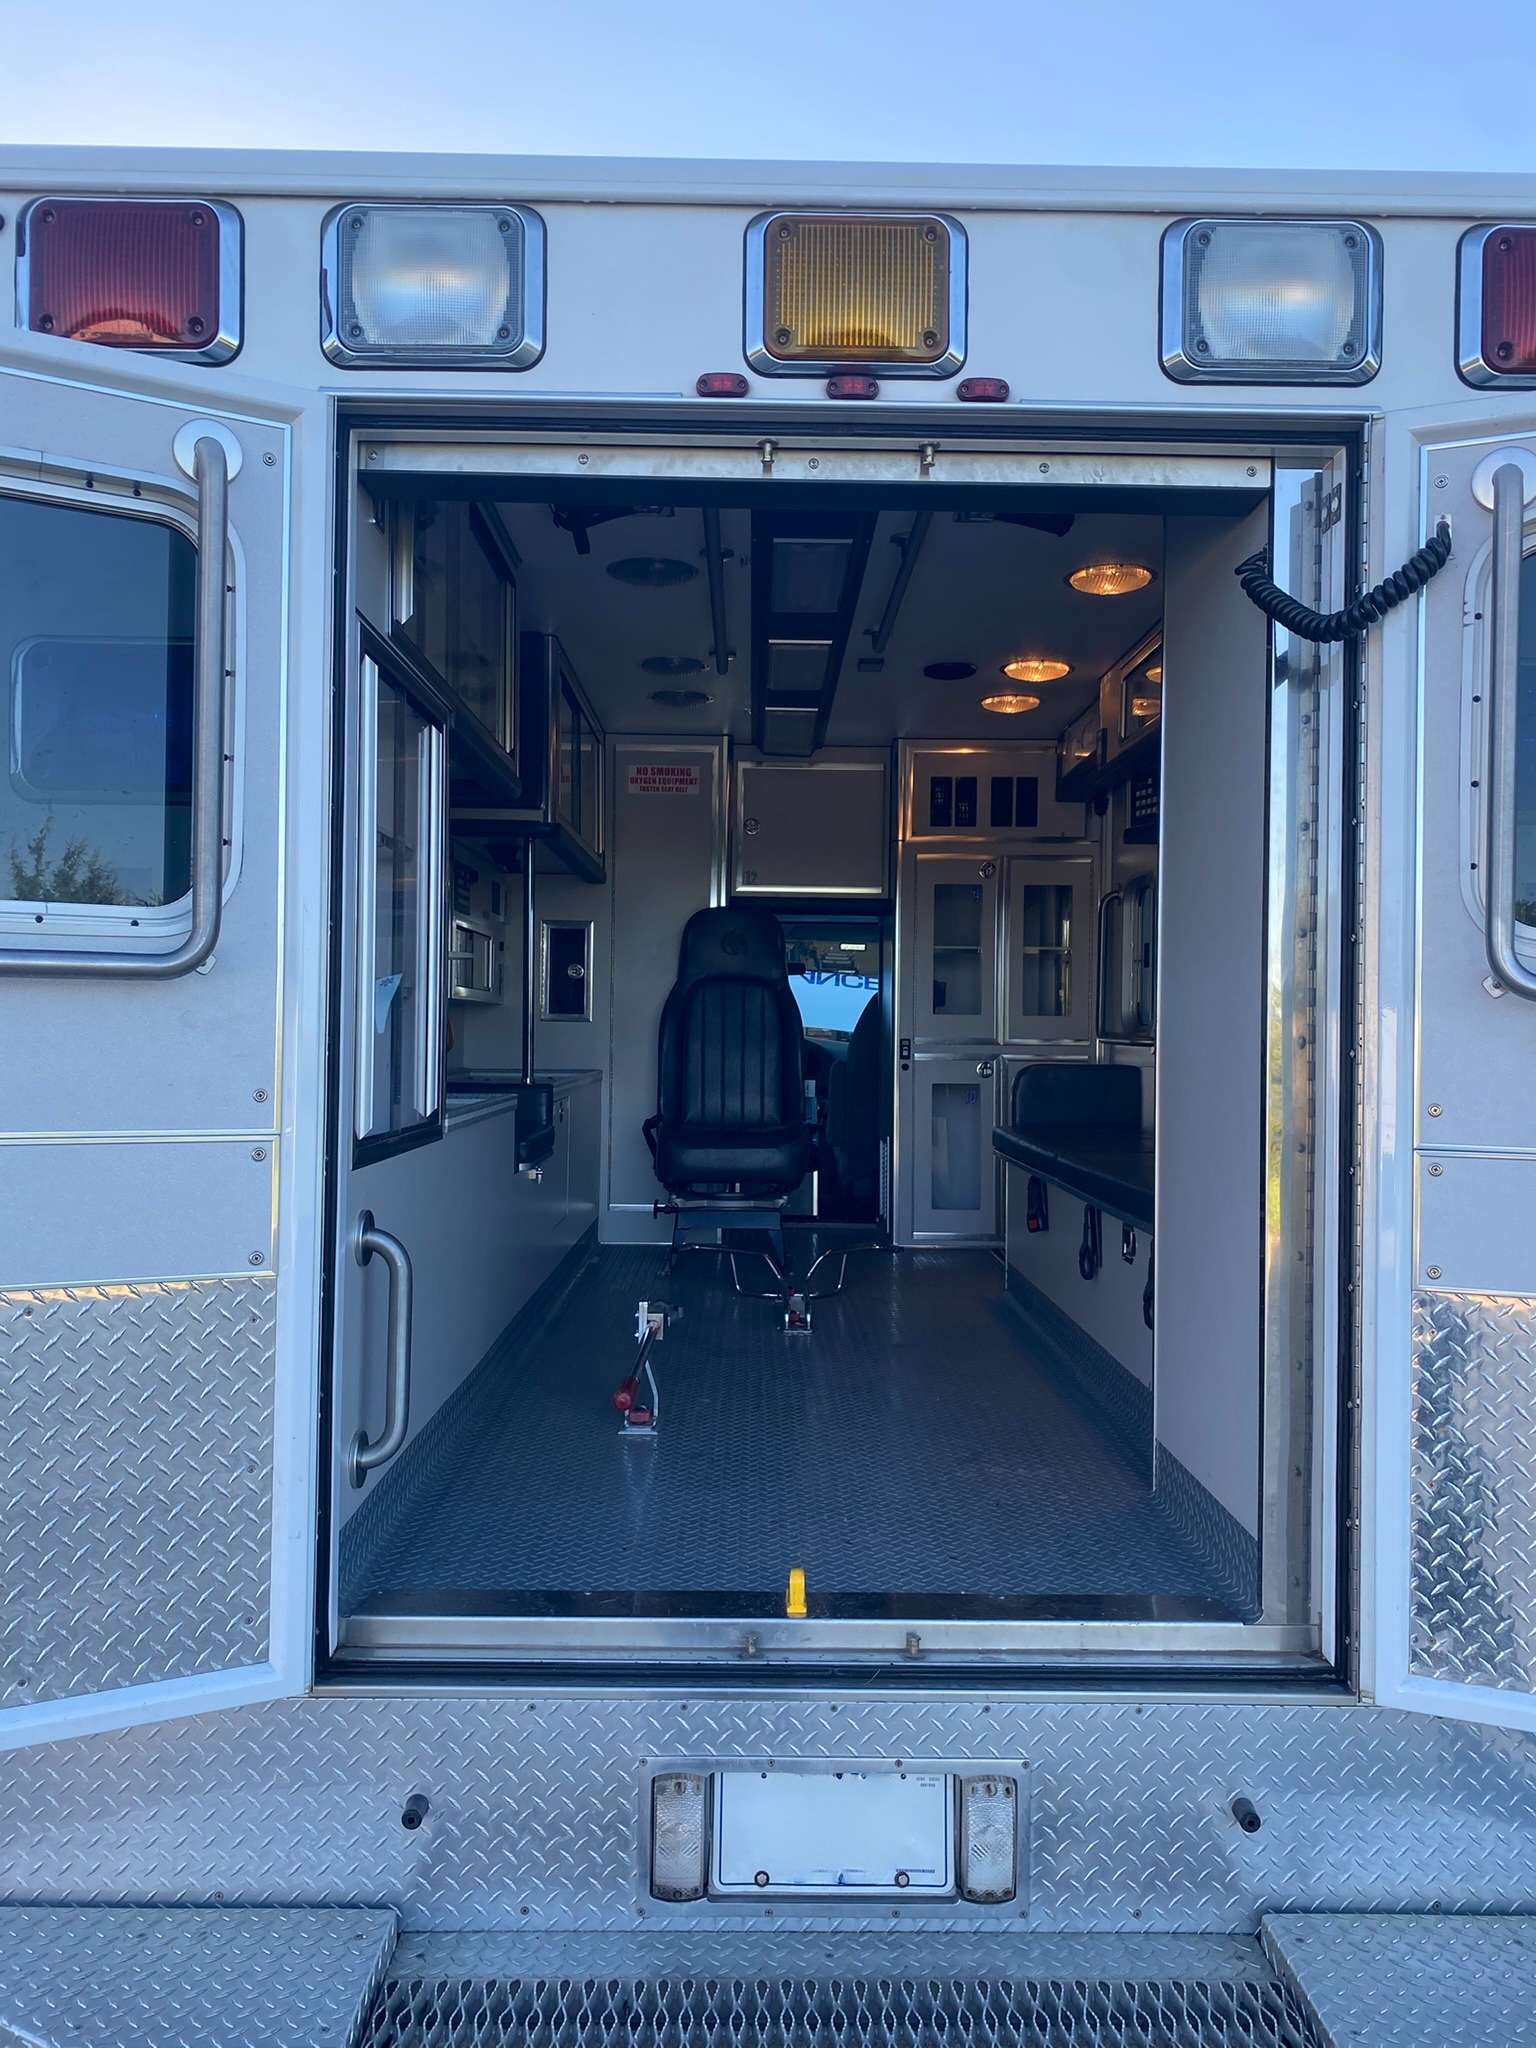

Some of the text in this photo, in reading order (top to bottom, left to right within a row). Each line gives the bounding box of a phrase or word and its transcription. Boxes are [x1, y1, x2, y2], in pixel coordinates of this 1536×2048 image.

[636, 767, 692, 777] NO SMOKING
[630, 776, 698, 786] OXYGEN EQUIPMENT
[640, 785, 660, 793] FASTEN
